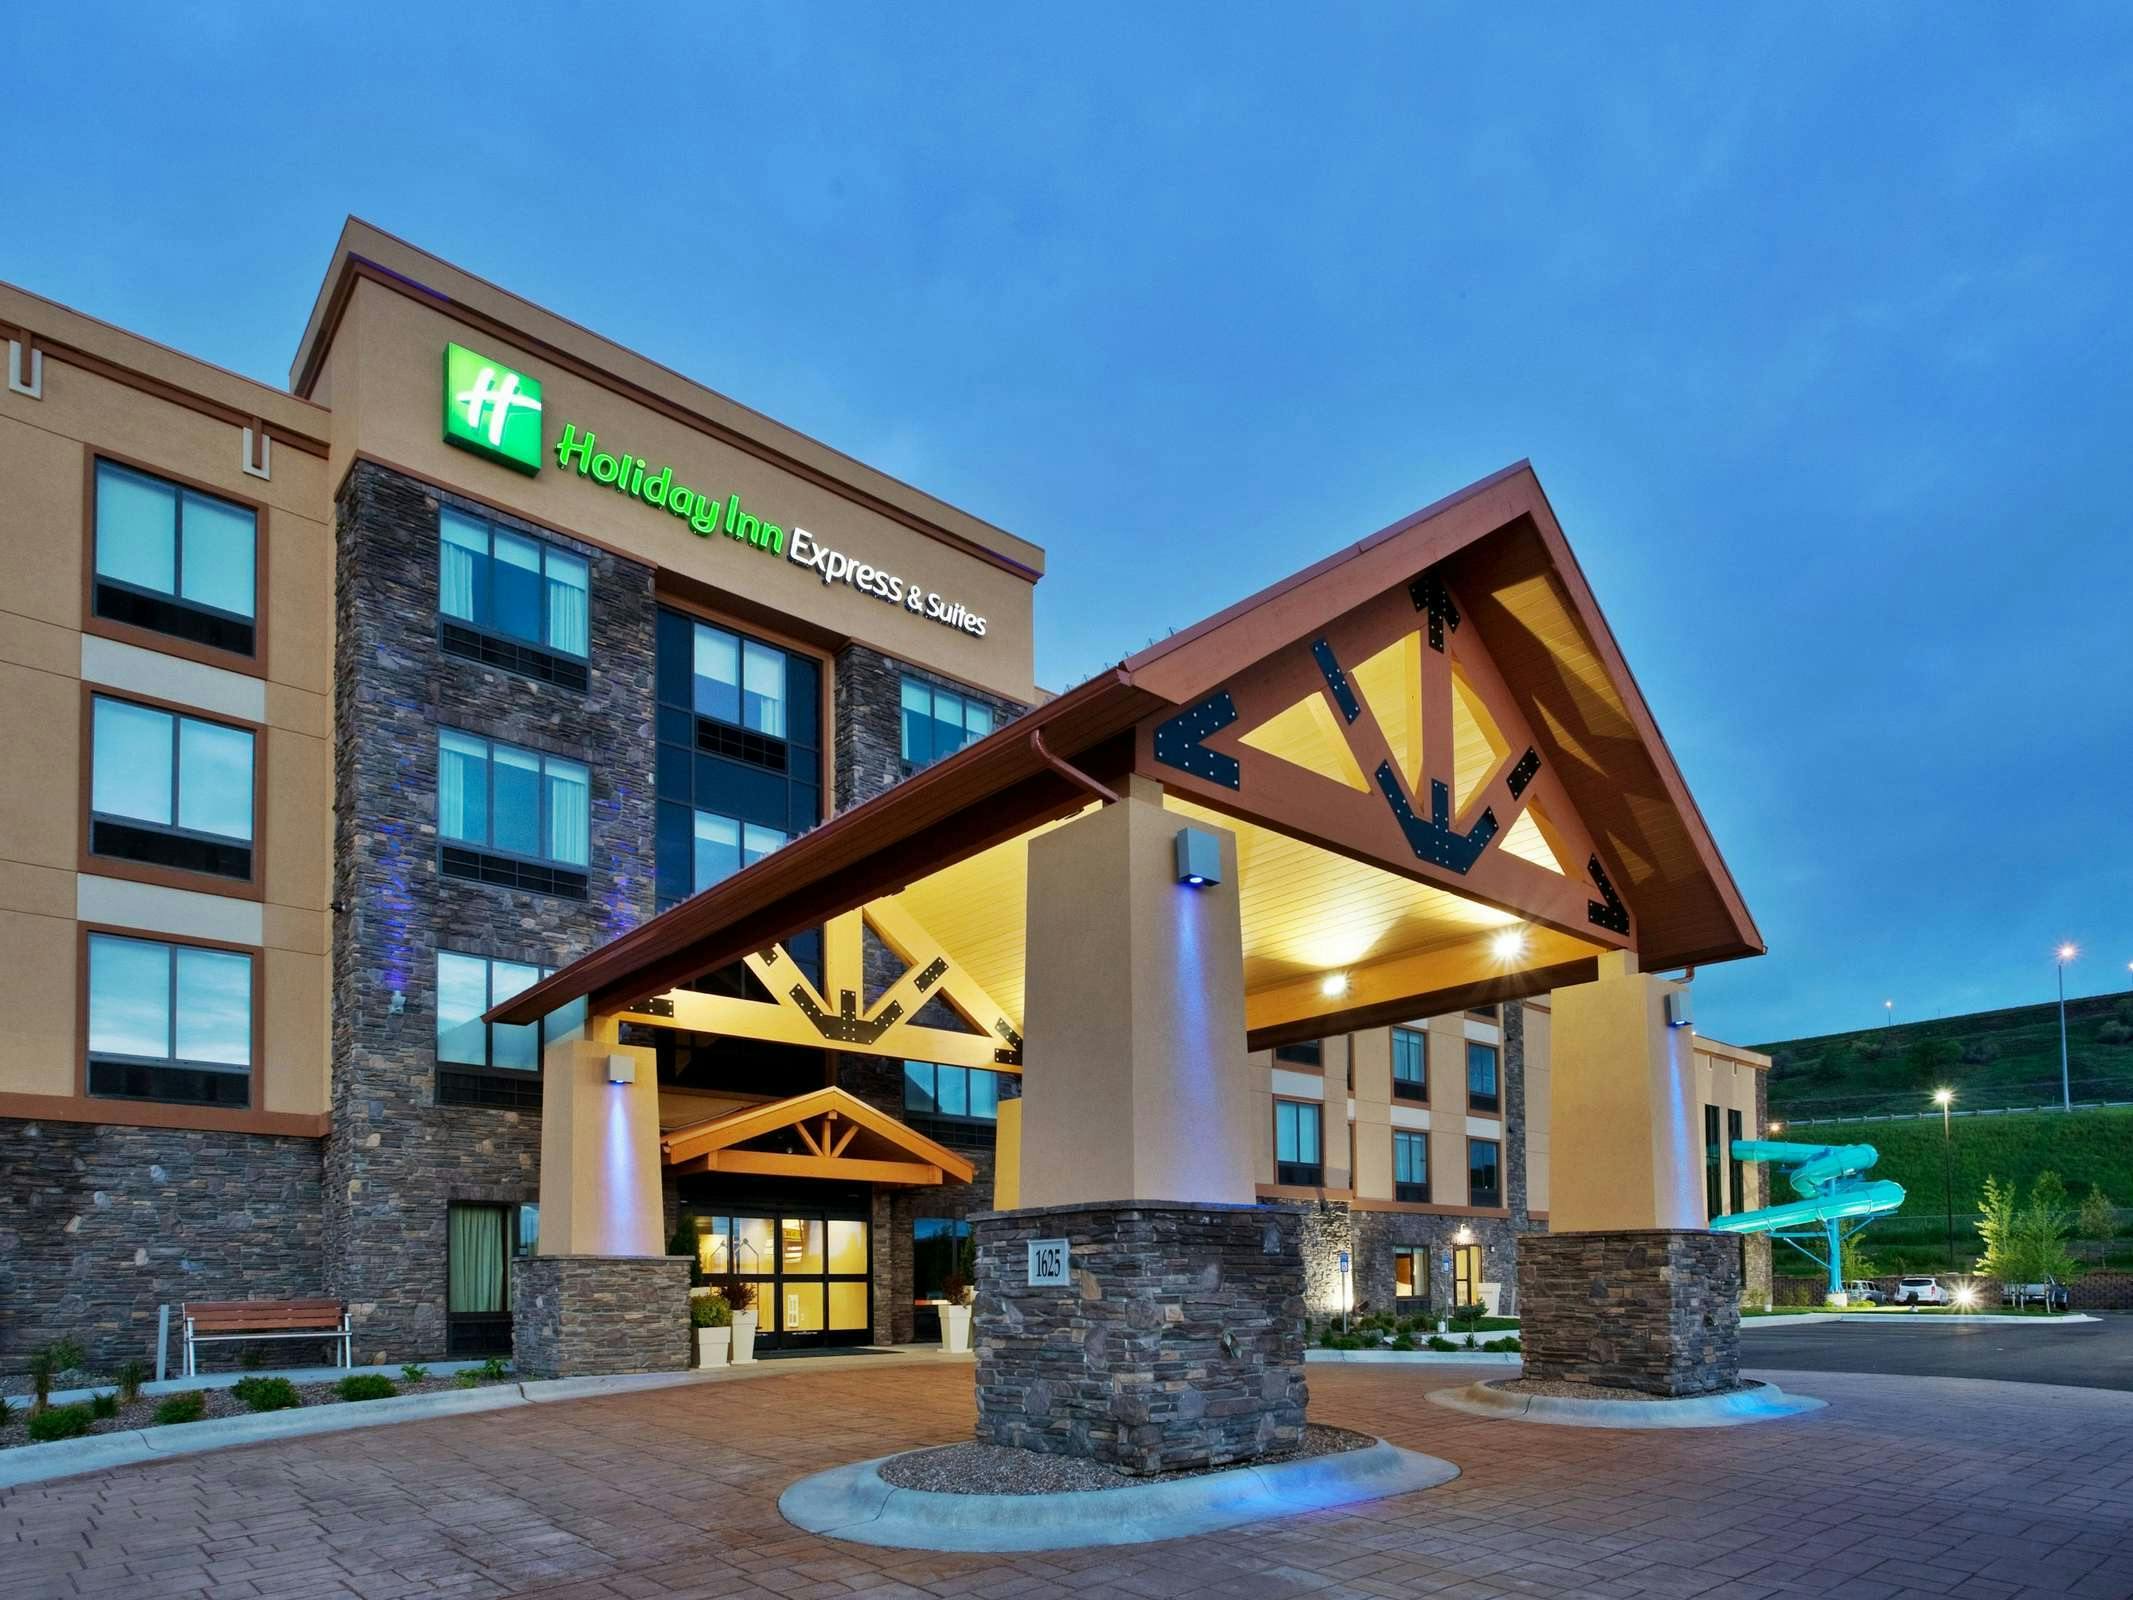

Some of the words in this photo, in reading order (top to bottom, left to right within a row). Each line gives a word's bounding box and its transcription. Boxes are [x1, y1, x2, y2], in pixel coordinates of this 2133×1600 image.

[555, 423, 721, 534] Holiday
[724, 493, 785, 555] Inn
[789, 527, 904, 602] Express
[906, 585, 923, 612] &
[925, 593, 987, 637] Suites
[1035, 1248, 1061, 1278] 1625
